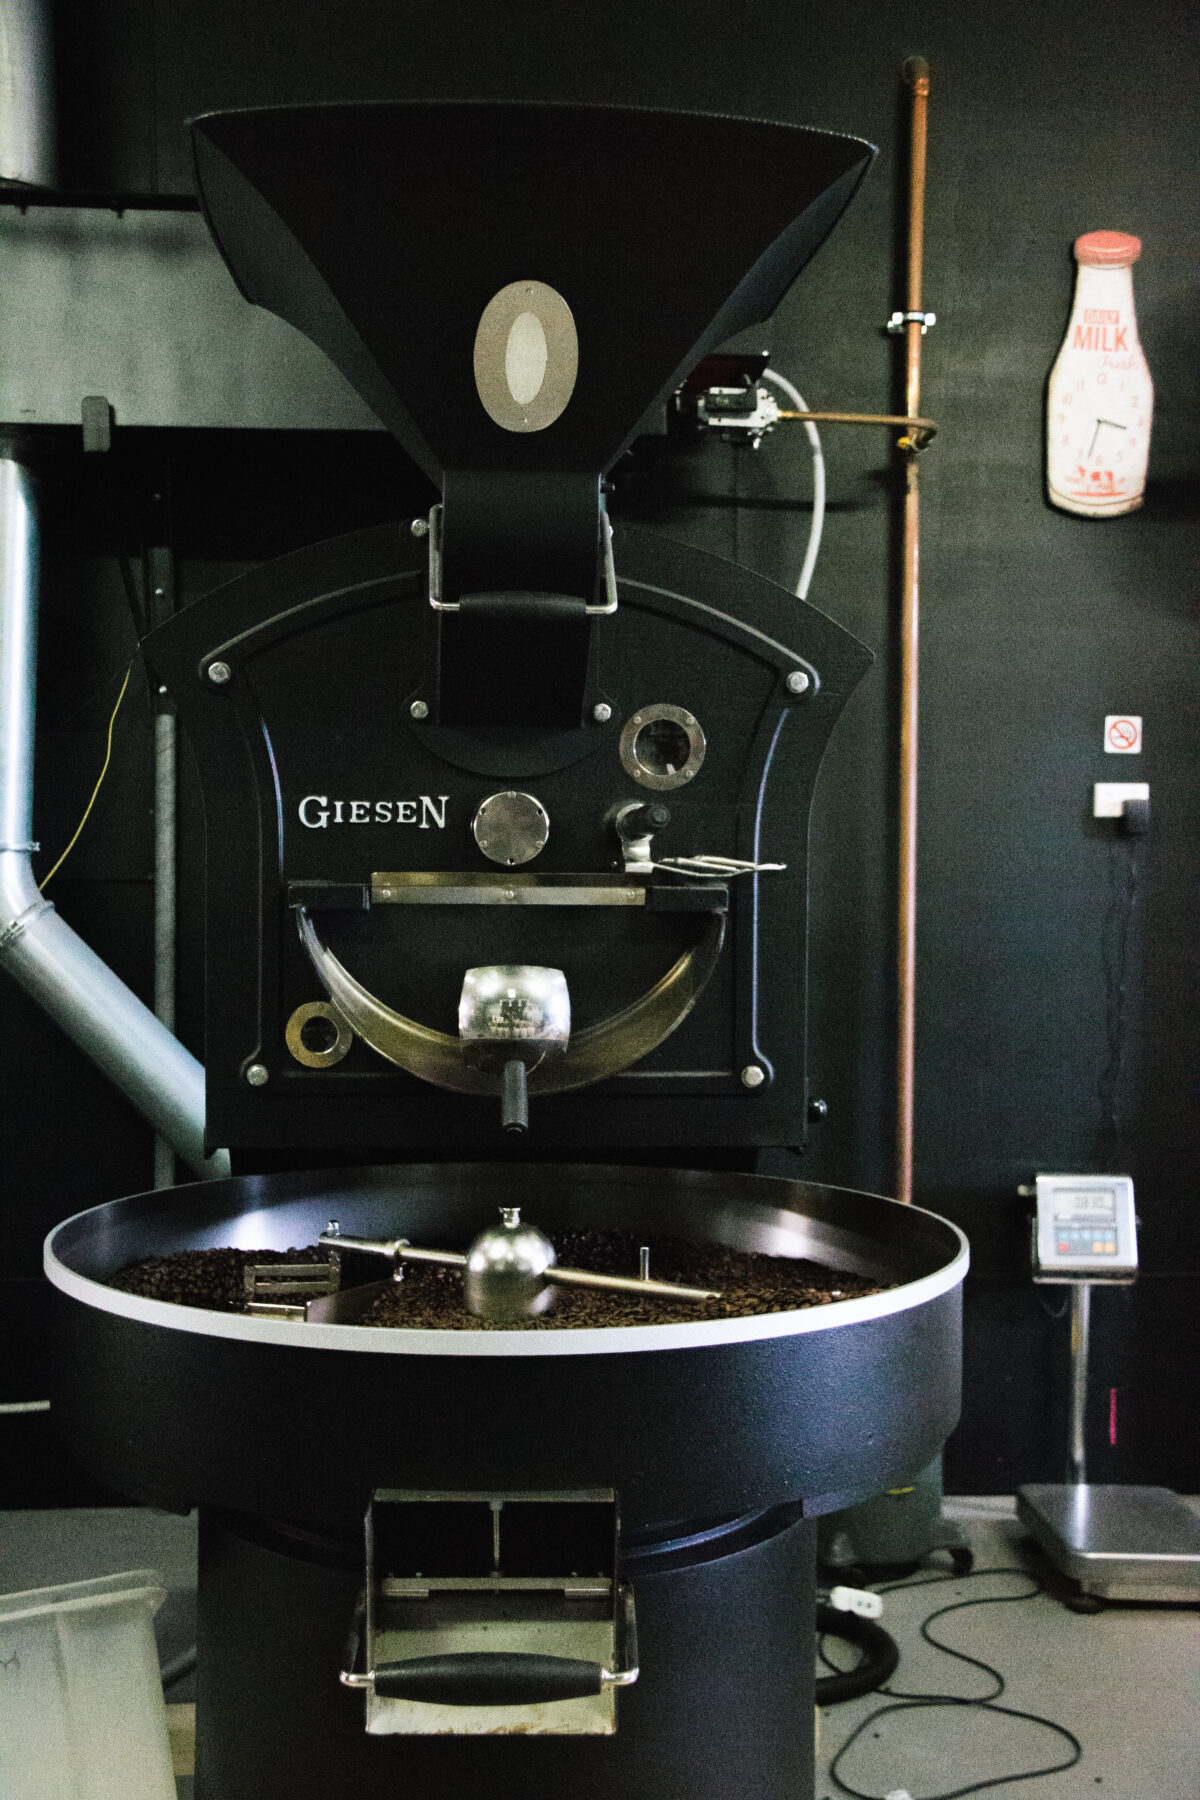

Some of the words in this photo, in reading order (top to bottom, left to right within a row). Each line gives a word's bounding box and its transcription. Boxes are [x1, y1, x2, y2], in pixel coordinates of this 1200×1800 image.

[1073, 325, 1128, 352] MILK
[1096, 372, 1107, 385] 12
[1062, 393, 1073, 406] 10
[1131, 395, 1139, 408] 2
[1057, 412, 1066, 423] 9
